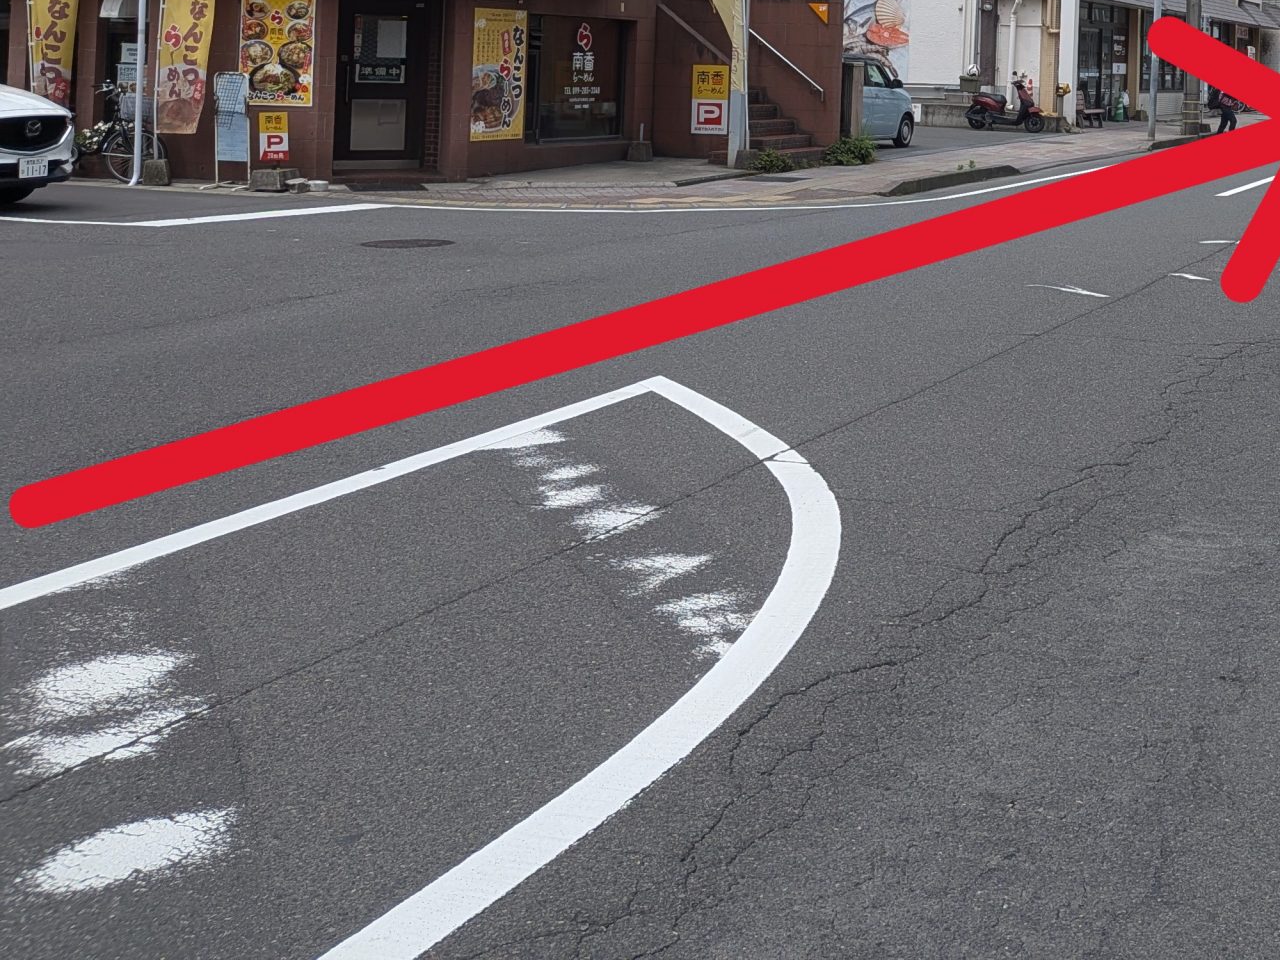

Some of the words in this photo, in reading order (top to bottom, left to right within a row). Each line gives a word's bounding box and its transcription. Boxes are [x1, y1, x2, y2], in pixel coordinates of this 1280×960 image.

[182, 0, 209, 86] なんこつ
[577, 22, 593, 51] ら
[511, 25, 525, 99] なんこつ
[572, 51, 595, 72] 南香
[696, 70, 725, 86] 南香
[499, 57, 512, 128] らーめん
[698, 105, 720, 123] P
[266, 134, 284, 149] P
